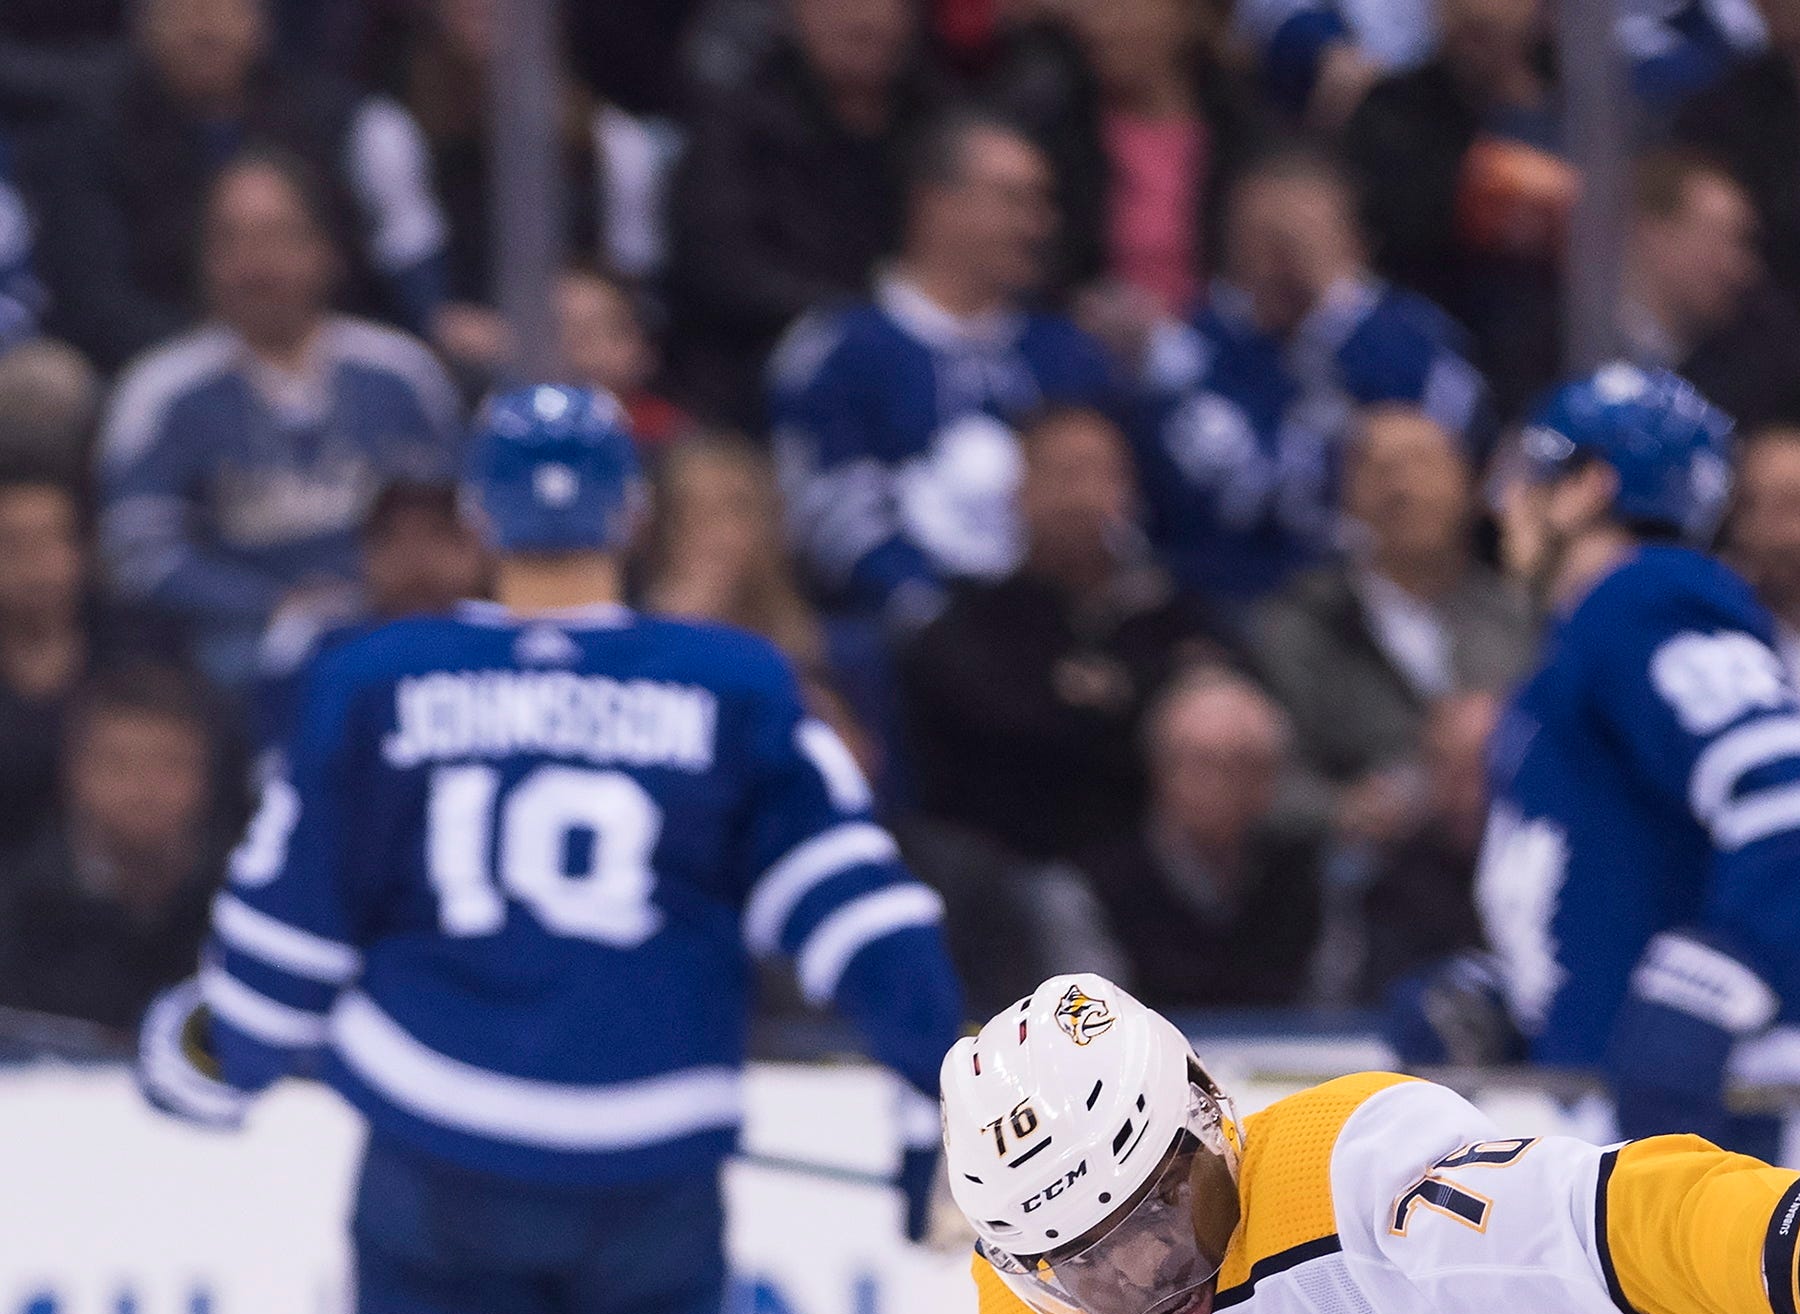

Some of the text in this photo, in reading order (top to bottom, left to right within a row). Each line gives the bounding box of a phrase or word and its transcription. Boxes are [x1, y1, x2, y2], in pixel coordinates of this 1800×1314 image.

[380, 668, 718, 772] JOHNSSON
[981, 1095, 1038, 1158] 76
[1021, 1159, 1088, 1213] CCM
[1778, 1201, 1800, 1236] SUBBAN
